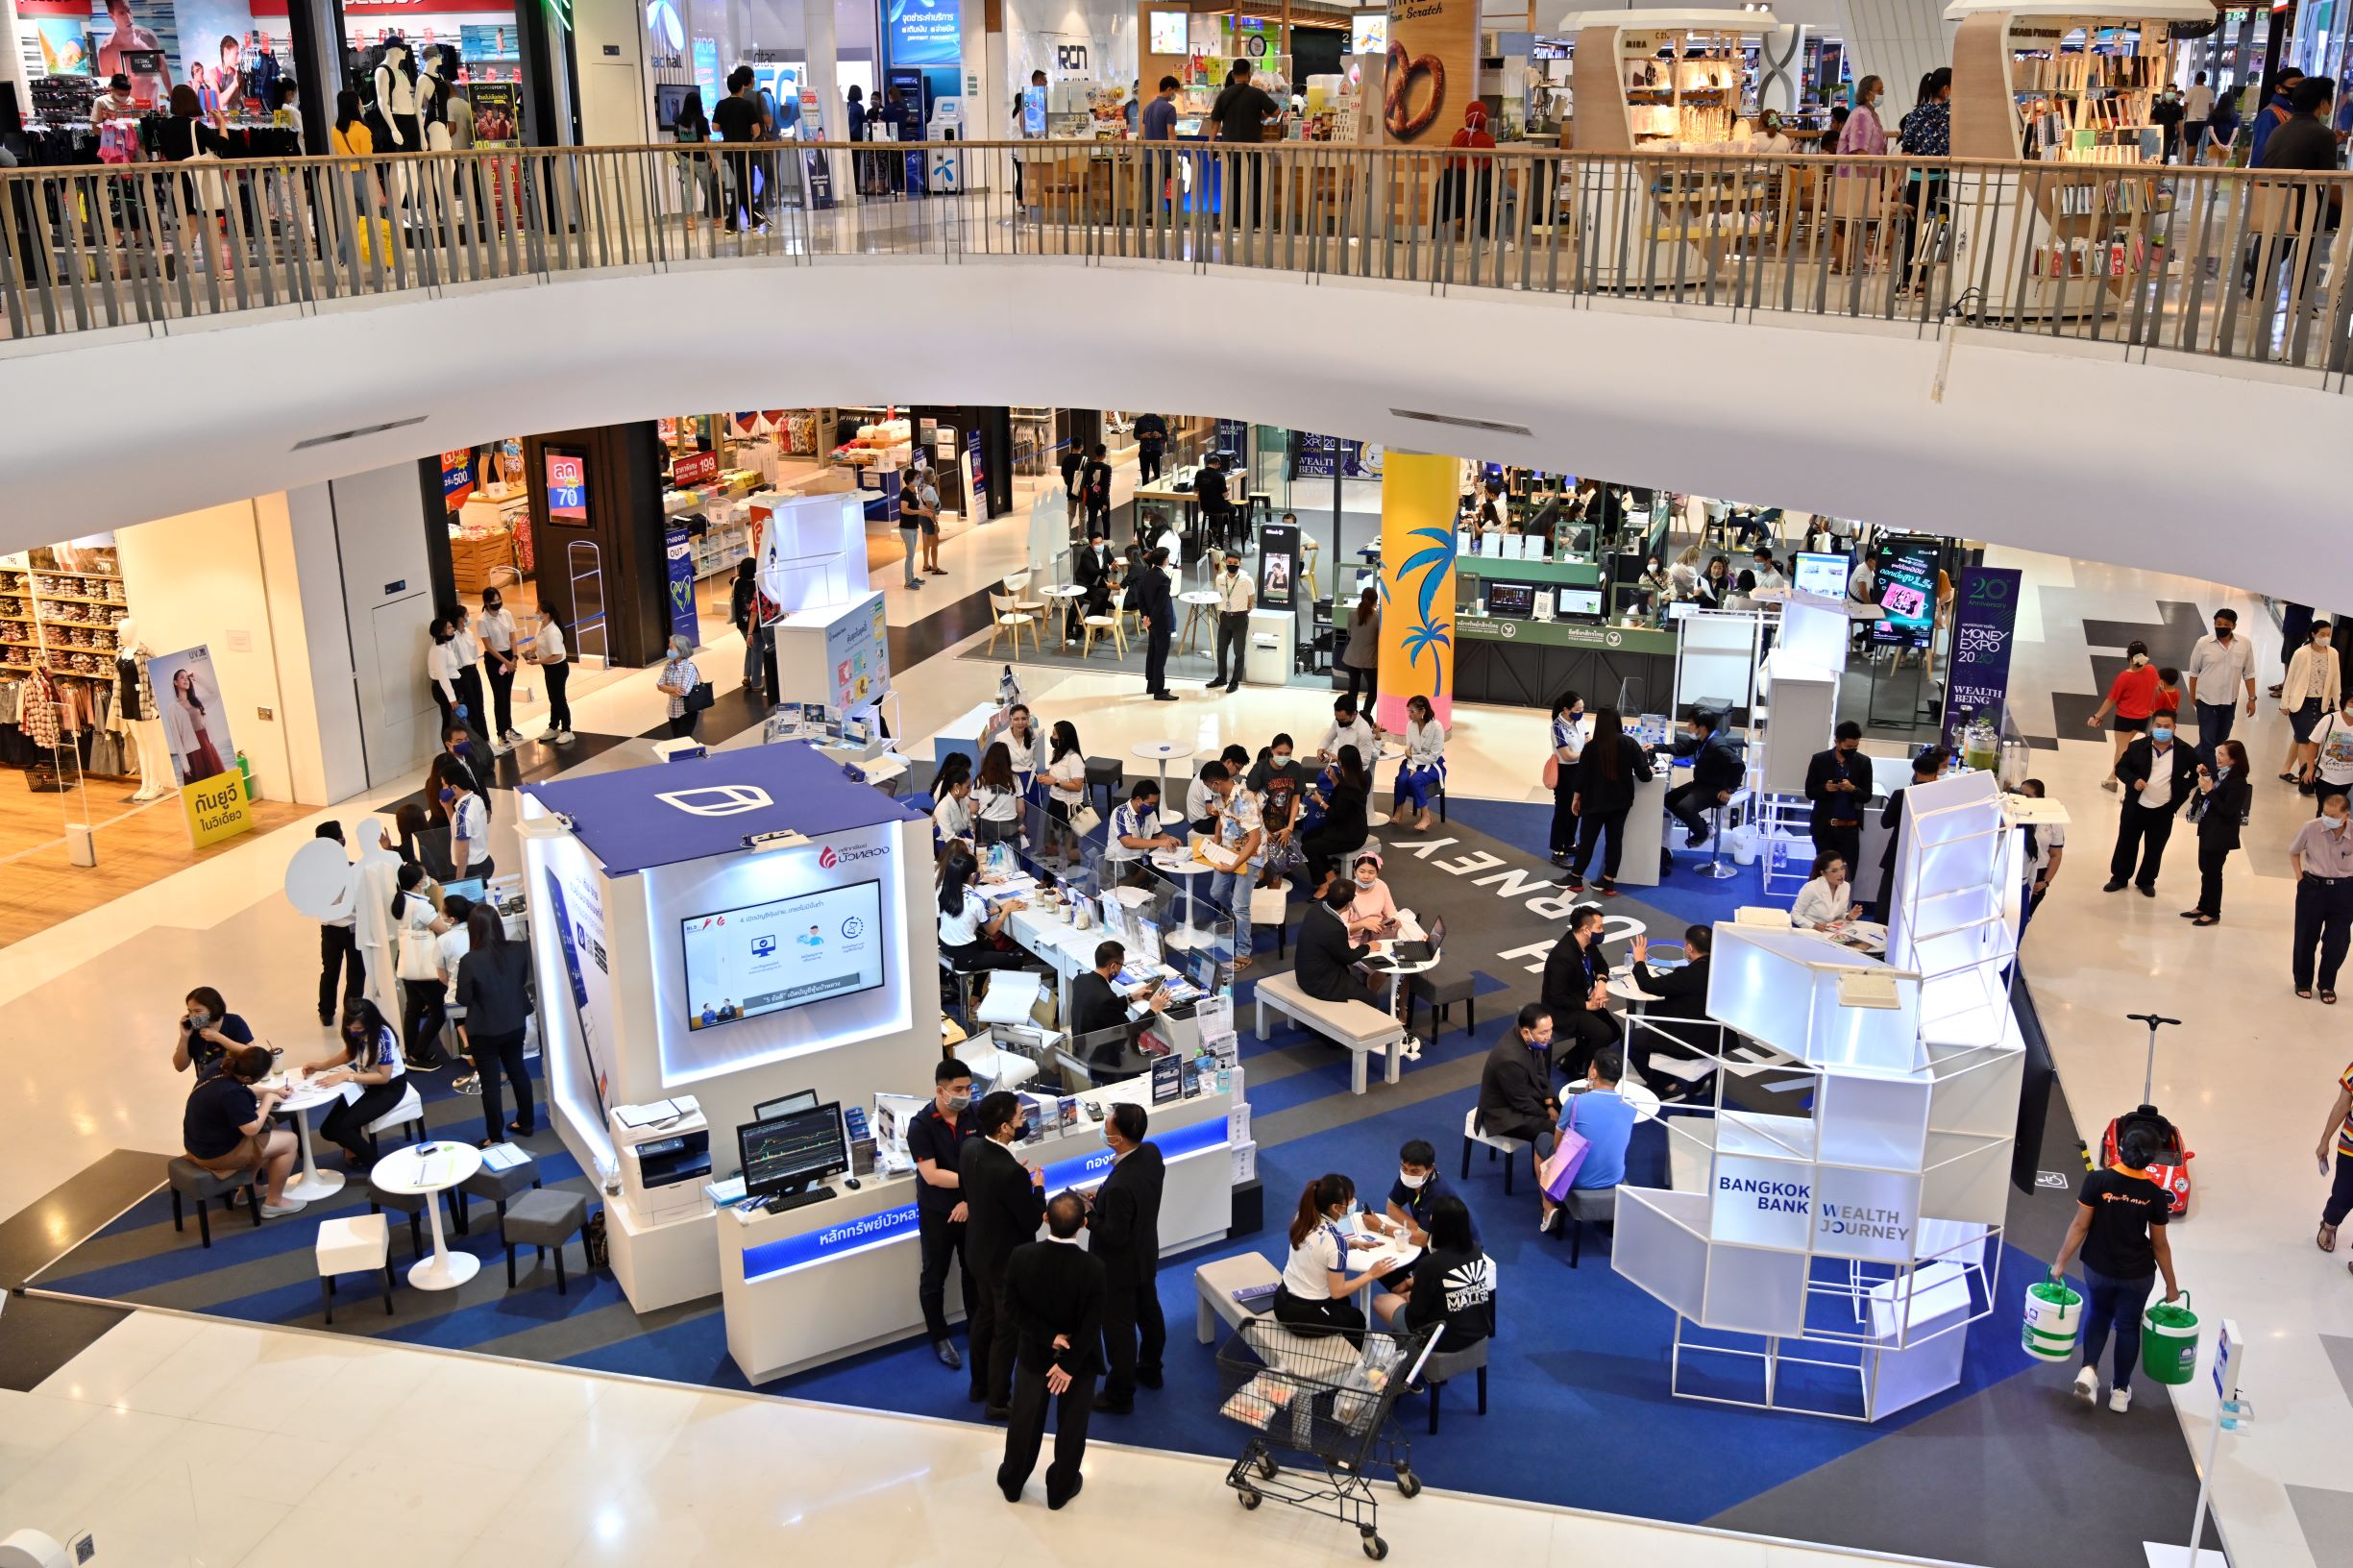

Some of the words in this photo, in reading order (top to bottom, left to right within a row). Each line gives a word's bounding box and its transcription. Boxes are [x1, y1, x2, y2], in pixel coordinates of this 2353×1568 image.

[902, 12, 954, 25] จุดชำระค่าบริการ
[1406, 5, 1444, 19] Scratch
[1341, 33, 1350, 43] 2
[2033, 28, 2062, 38] PHONE
[665, 54, 683, 68] hall
[753, 49, 776, 67] dtac
[553, 463, 576, 479] ลด
[1299, 466, 1328, 475] BEING
[670, 547, 683, 558] OUT
[1968, 600, 2007, 609] Anniversary
[1960, 628, 2010, 641] MONEY
[1959, 638, 2000, 652] EXPO
[1953, 685, 2003, 698] WEALTH
[1954, 694, 1991, 705] BEING
[195, 782, 239, 814] กันยูวี
[199, 809, 243, 833] ในวิเดียว
[838, 845, 891, 863] บัวหลวง
[1719, 1176, 1811, 1199] BANGKOK
[1757, 1196, 1809, 1213] BANK
[1823, 1203, 1900, 1224] WEALTH
[1820, 1219, 1910, 1241] JOURNEY
